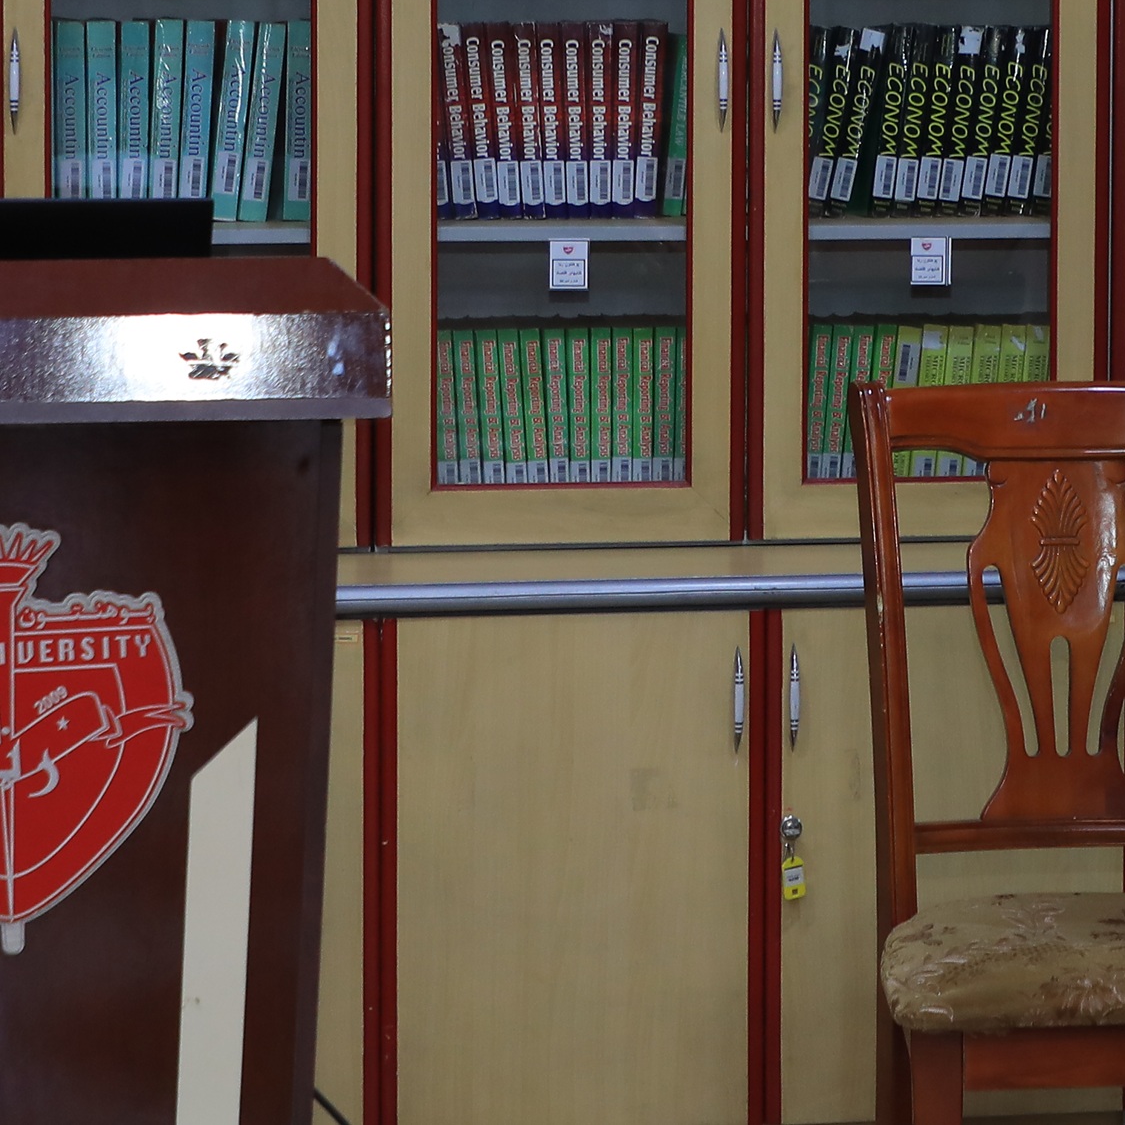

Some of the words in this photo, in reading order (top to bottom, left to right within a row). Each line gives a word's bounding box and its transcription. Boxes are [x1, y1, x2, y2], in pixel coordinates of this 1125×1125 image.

[466, 37, 483, 100] Consumer
[491, 40, 507, 103] Consumer
[517, 39, 533, 102] Consumer
[541, 39, 555, 102] Consumer
[566, 40, 579, 102] Consumer
[592, 39, 606, 102] Consumer
[618, 39, 632, 102] Consumer
[643, 37, 659, 99] Consumer
[65, 73, 80, 160] Accountin
[96, 72, 112, 159] Accountin
[129, 71, 145, 159] Accountin
[188, 68, 207, 156] Accountin
[294, 72, 310, 159] Accountin
[472, 103, 490, 157] Behavior
[497, 106, 513, 161] Behavior
[522, 106, 537, 160] Behavior
[544, 106, 558, 160] Behavior
[568, 106, 583, 160] Behavior
[593, 106, 607, 160] Behavior
[618, 106, 632, 160] Behavior
[641, 103, 656, 156] Behavior
[819, 64, 846, 157] ECONOM
[842, 65, 875, 158] ECONOM
[880, 63, 904, 156] ECONOM
[901, 63, 928, 158] ECONOM
[926, 63, 951, 156] ECONOM
[950, 65, 975, 157] ECONOM
[973, 64, 1000, 156] ECONOM
[995, 61, 1023, 154] ECONOM
[1019, 64, 1047, 156] ECONOM
[0, 634, 151, 666] IVERSITY
[33, 685, 69, 714] 2009
